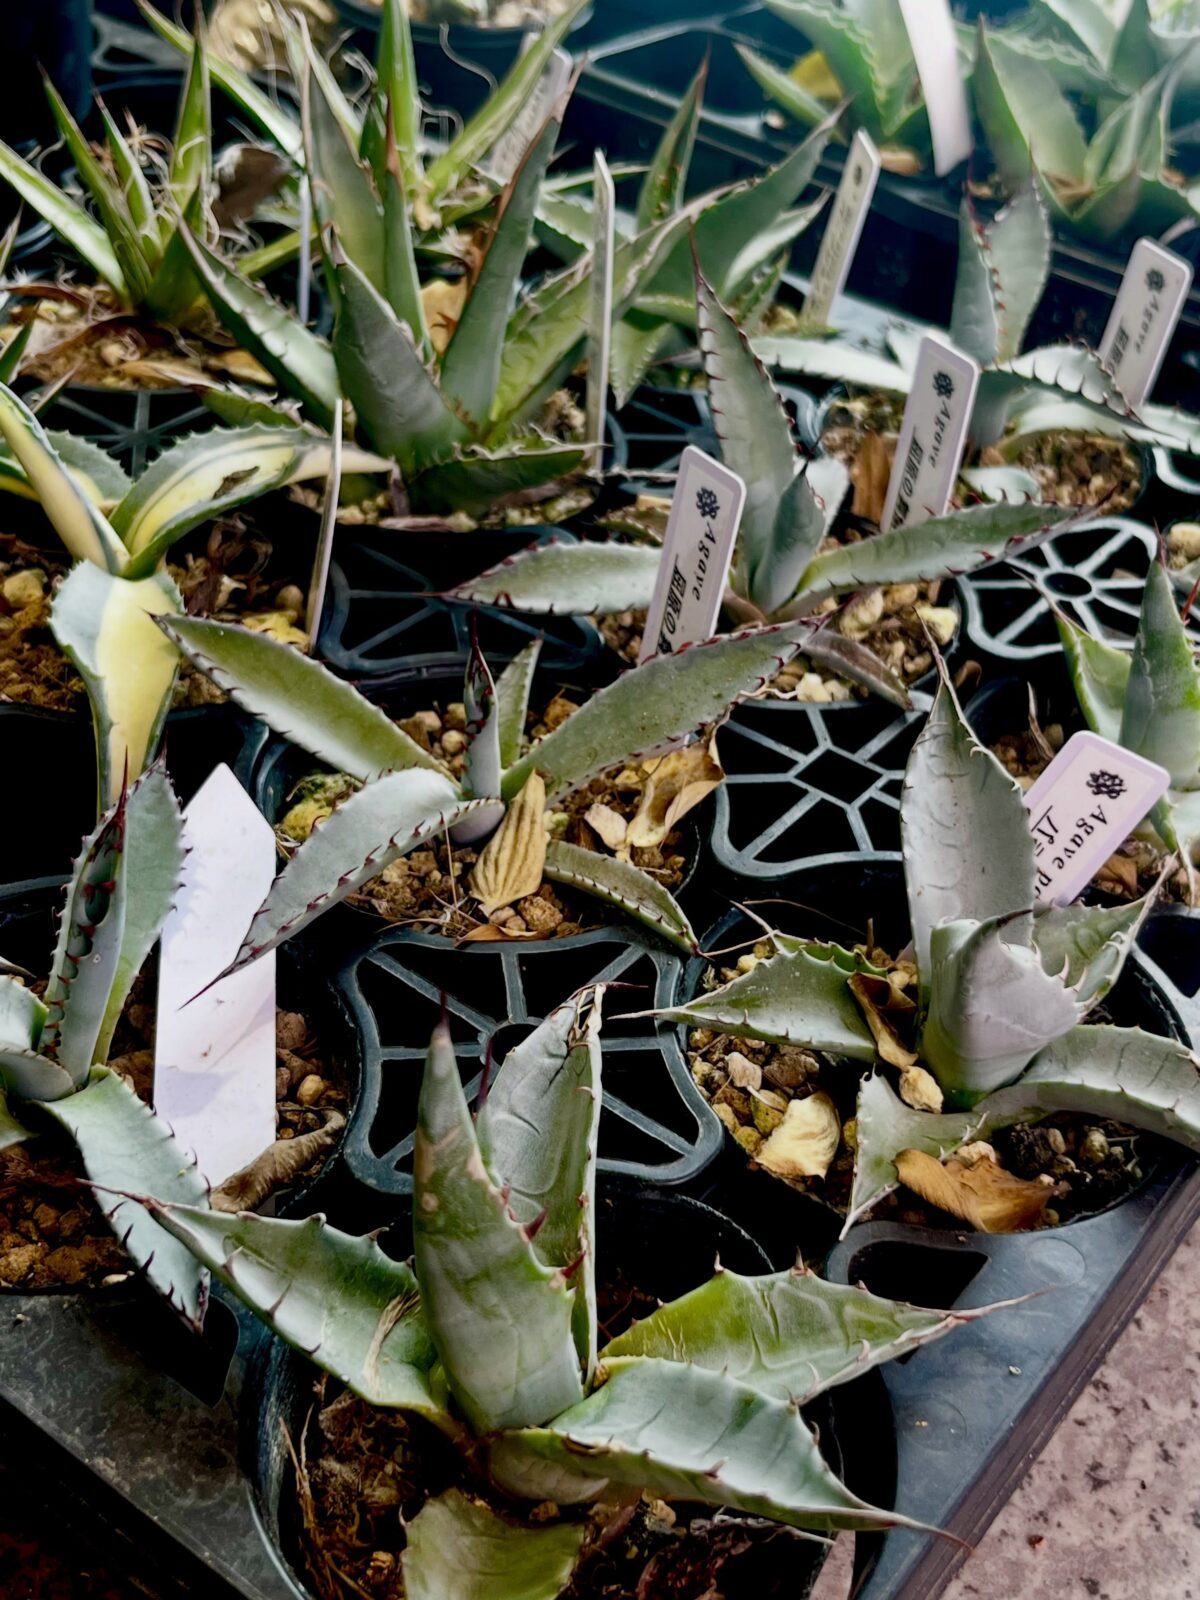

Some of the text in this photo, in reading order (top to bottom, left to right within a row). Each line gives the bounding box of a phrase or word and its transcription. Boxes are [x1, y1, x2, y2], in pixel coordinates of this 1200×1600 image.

[929, 401, 952, 469] Agave
[691, 522, 717, 601] Agave
[1052, 804, 1108, 870] Agave
